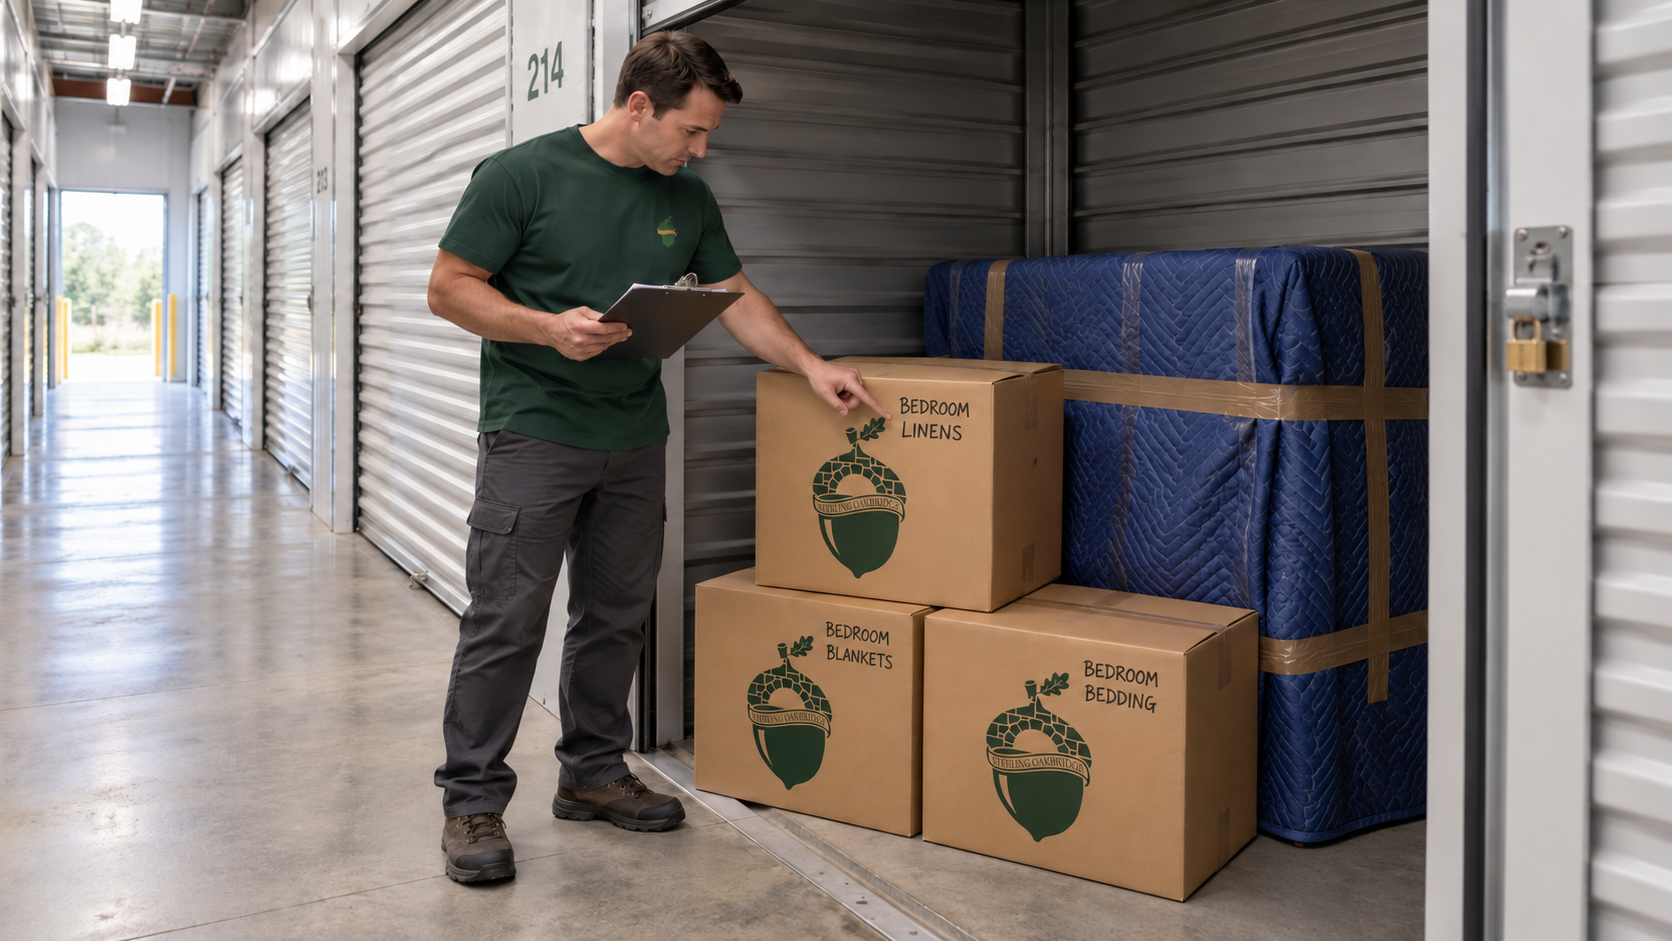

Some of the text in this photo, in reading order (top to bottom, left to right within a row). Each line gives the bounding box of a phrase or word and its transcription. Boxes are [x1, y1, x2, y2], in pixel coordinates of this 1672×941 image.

[527, 40, 565, 102] 214
[317, 166, 328, 194] 213
[899, 396, 970, 418] BEDROOM
[901, 420, 963, 441] LINENS
[817, 497, 899, 513] TLING OAKID
[825, 620, 890, 646] BEDROOM
[826, 643, 894, 670] BLANKETS
[1083, 659, 1159, 688] BEDROOM
[1084, 683, 1158, 714] BEDDING
